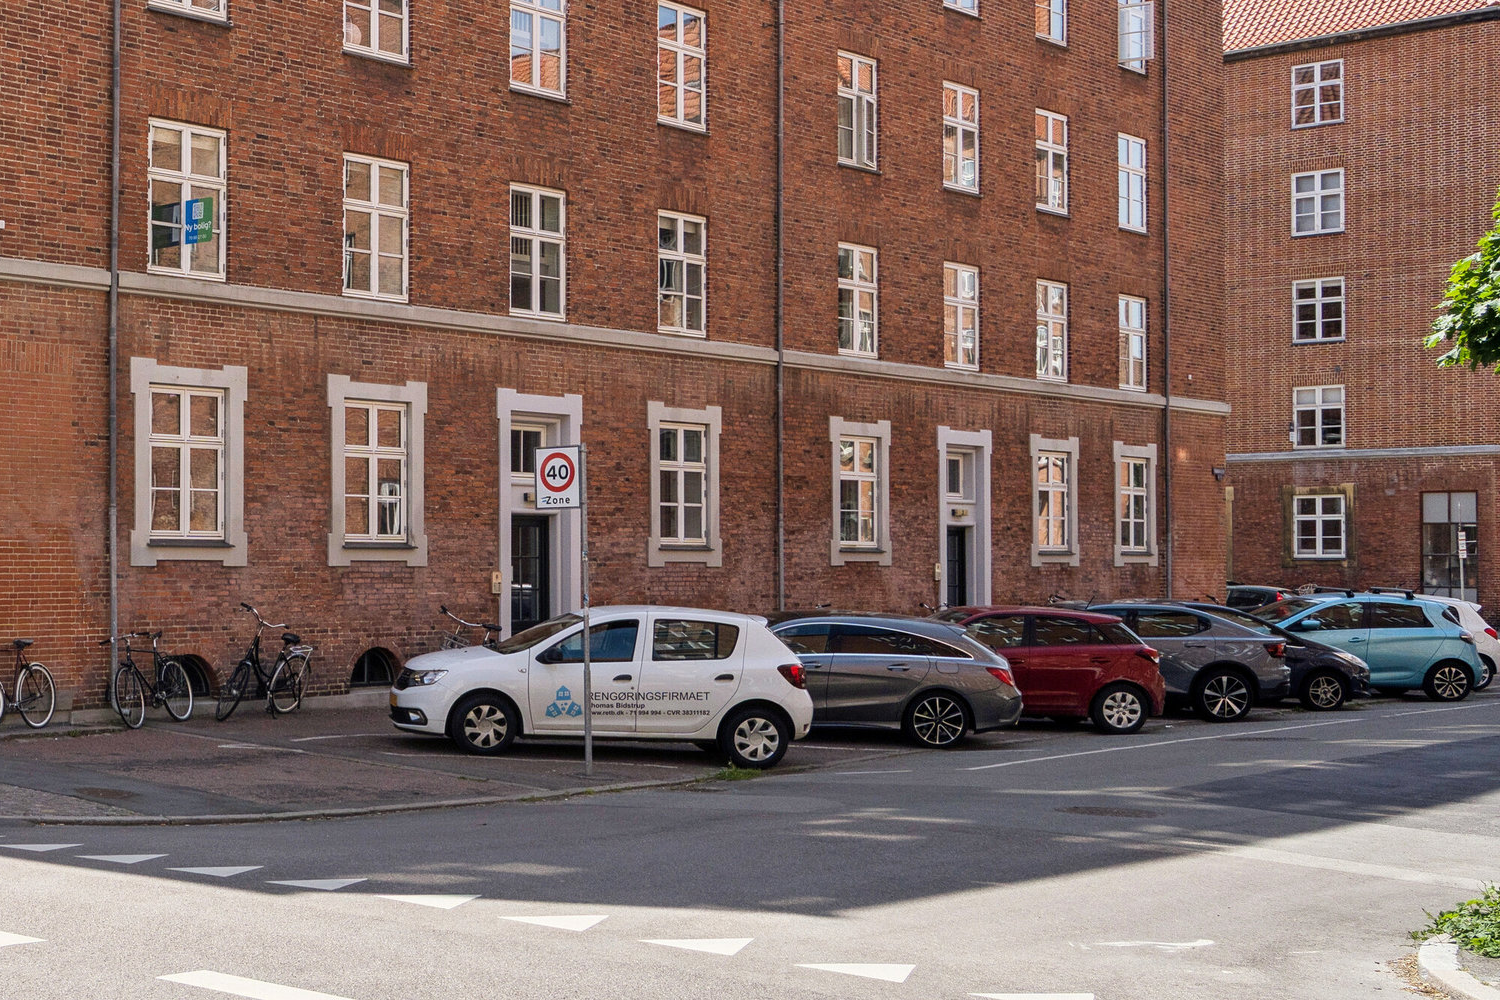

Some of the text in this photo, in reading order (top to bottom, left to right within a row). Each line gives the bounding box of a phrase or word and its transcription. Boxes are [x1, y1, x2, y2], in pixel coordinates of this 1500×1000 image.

[184, 220, 212, 233] Ny bolig?
[546, 464, 569, 480] 40
[546, 496, 571, 505] Zone
[615, 702, 646, 710] Bidstrup
